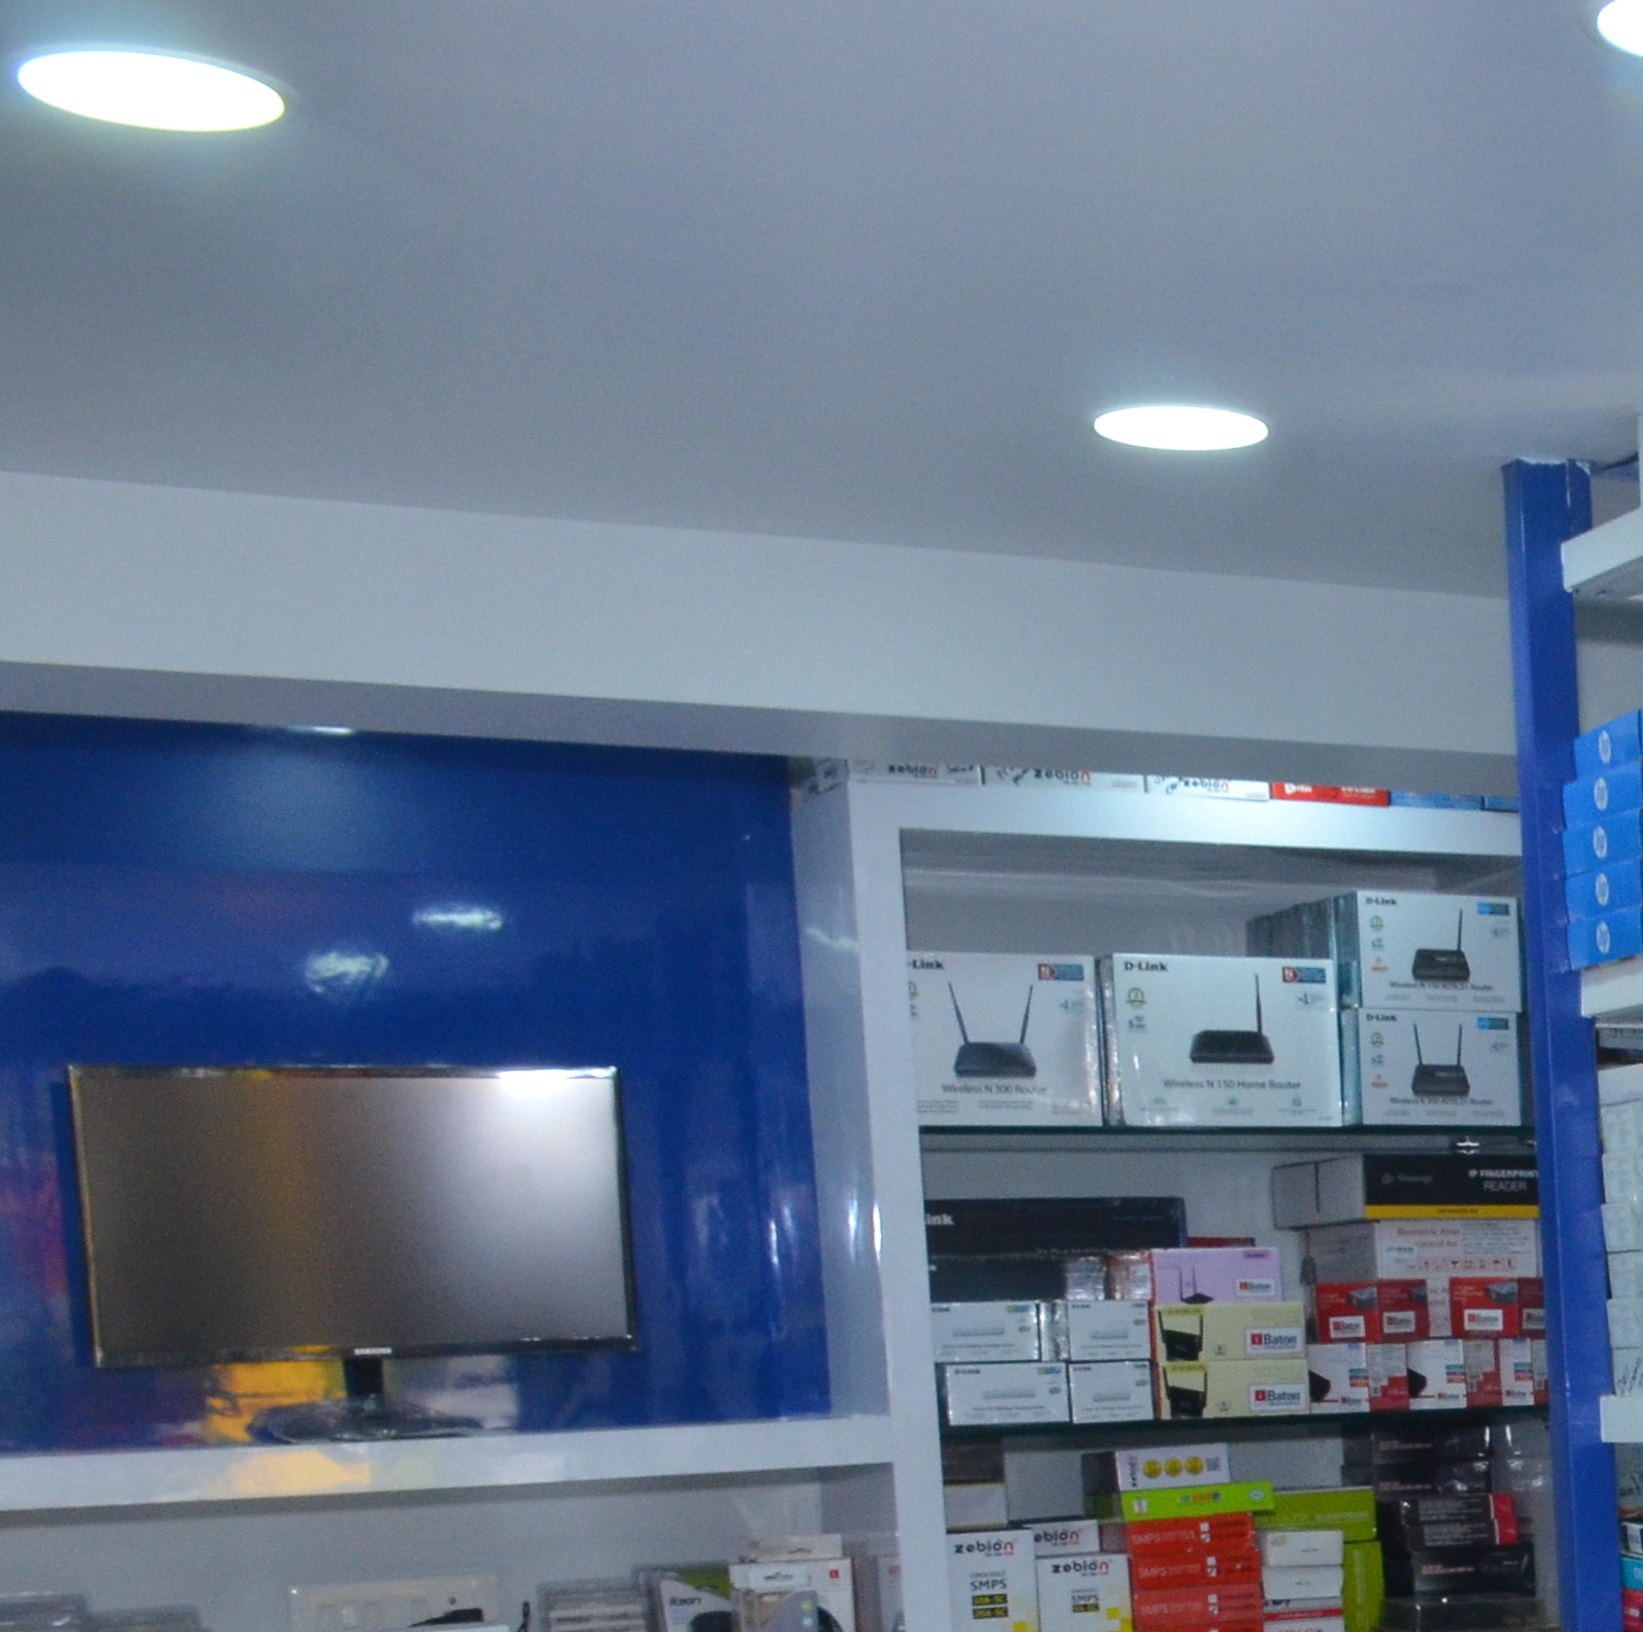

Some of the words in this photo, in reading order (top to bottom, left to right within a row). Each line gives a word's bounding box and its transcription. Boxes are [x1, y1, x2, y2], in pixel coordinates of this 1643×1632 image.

[1124, 961, 1168, 971] D-Link
[1484, 1181, 1526, 1190] READER
[1263, 1334, 1297, 1344] Baton
[1267, 1390, 1300, 1401] Baton
[971, 1579, 1006, 1591] SMPS
